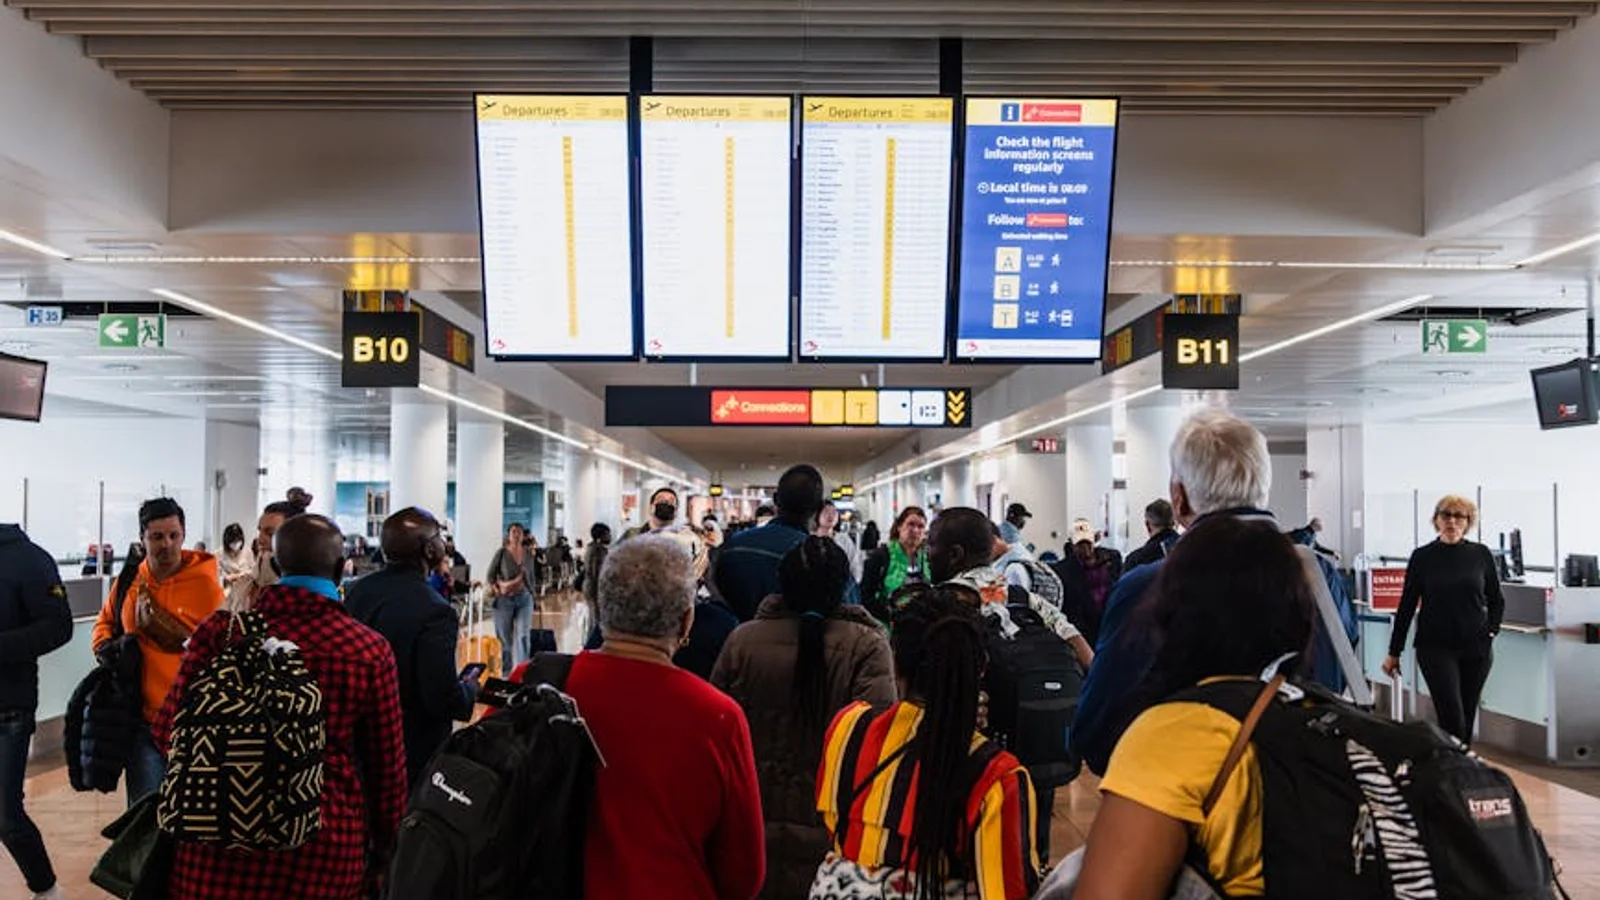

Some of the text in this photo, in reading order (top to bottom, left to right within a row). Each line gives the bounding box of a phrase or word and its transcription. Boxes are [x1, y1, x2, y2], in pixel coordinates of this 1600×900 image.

[502, 104, 568, 117] Departures
[666, 105, 731, 118] Departures
[828, 106, 893, 119] Departures
[996, 136, 1084, 150] Check the flight
[984, 148, 1094, 160] information screens
[1013, 162, 1064, 175] regularly
[990, 182, 1019, 193] Local
[1020, 182, 1047, 193] time
[1048, 182, 1059, 193] is
[987, 213, 1025, 226] Follow
[1003, 256, 1014, 269] A
[1001, 284, 1011, 297] B
[1001, 311, 1010, 325] T
[353, 337, 409, 363] B10
[1177, 339, 1229, 364] B11
[741, 402, 806, 413] Connections
[856, 402, 867, 418] T
